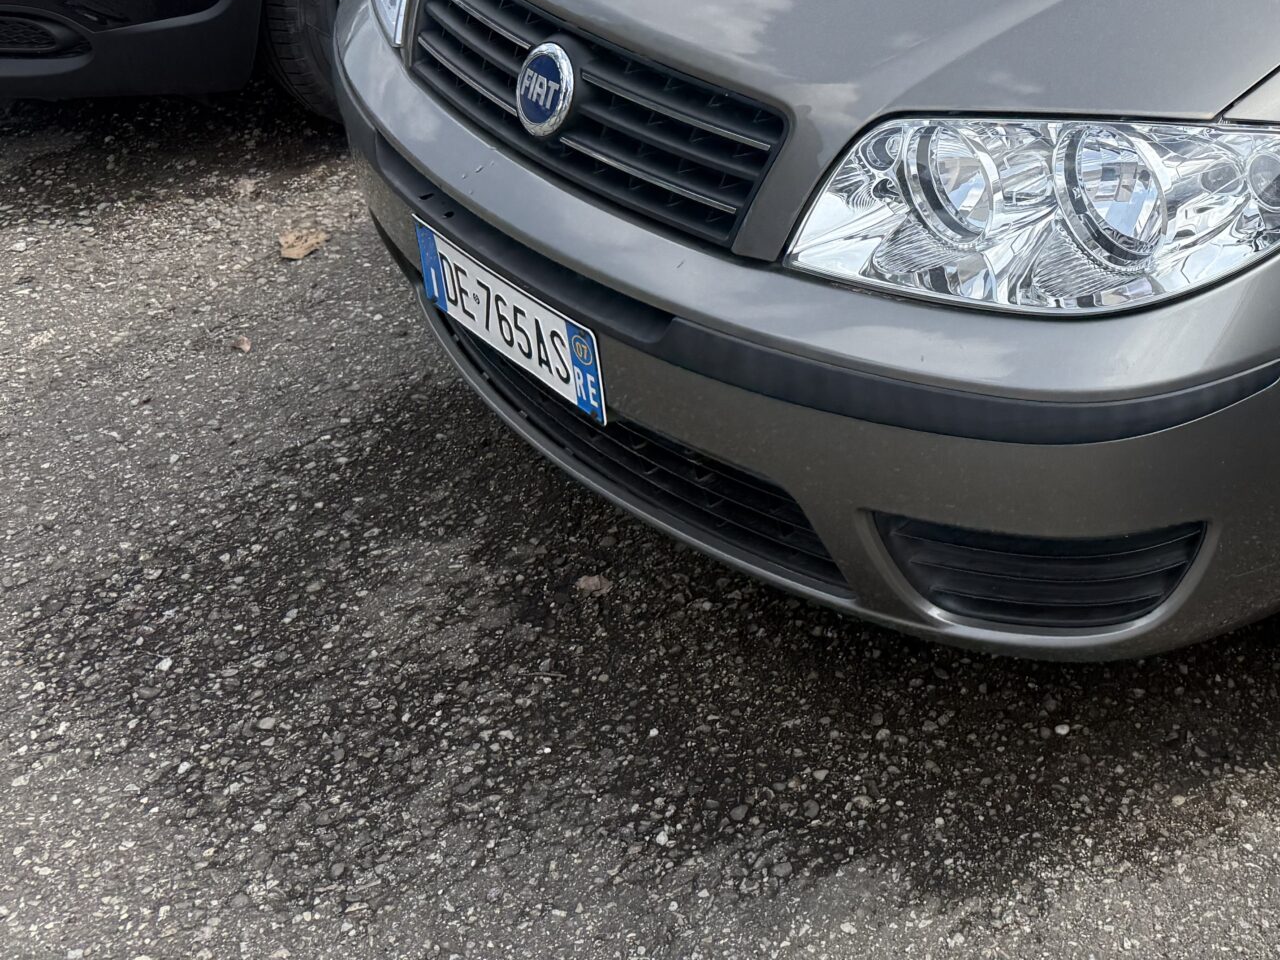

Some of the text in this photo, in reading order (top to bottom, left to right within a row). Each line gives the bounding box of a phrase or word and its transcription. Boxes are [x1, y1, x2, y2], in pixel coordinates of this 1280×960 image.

[520, 67, 561, 110] FIAT
[574, 341, 589, 362] 07
[573, 364, 599, 408] RE
